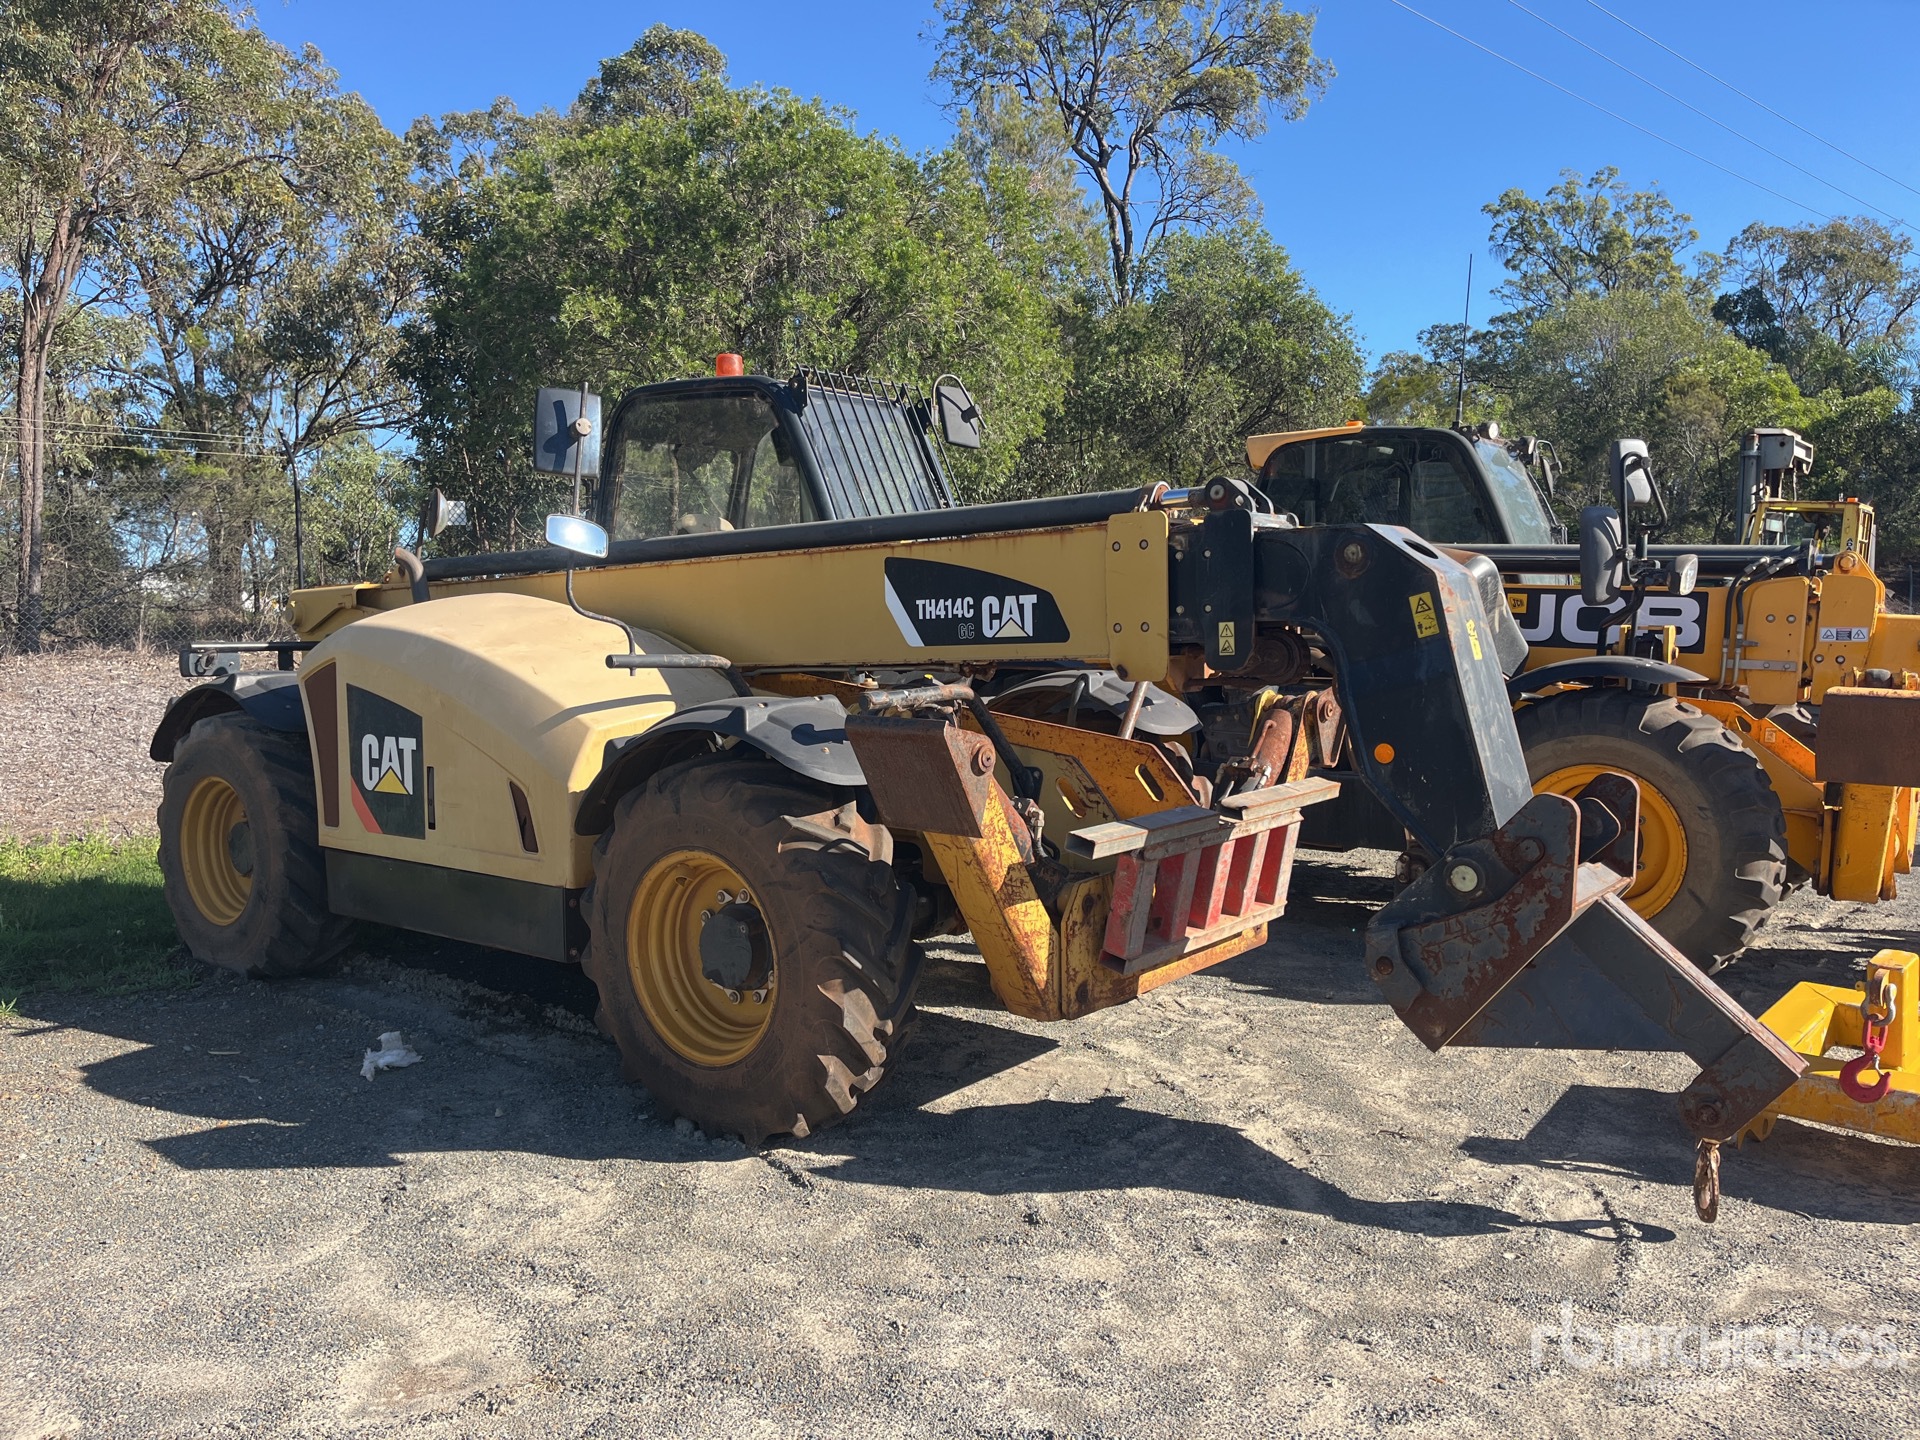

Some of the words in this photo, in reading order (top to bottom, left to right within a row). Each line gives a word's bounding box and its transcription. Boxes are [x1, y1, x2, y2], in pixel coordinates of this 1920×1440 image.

[916, 597, 974, 619] TH414C
[981, 594, 1038, 638] CAT
[1515, 593, 1700, 647] JCB
[958, 623, 975, 639] GC
[361, 733, 417, 795] CAT
